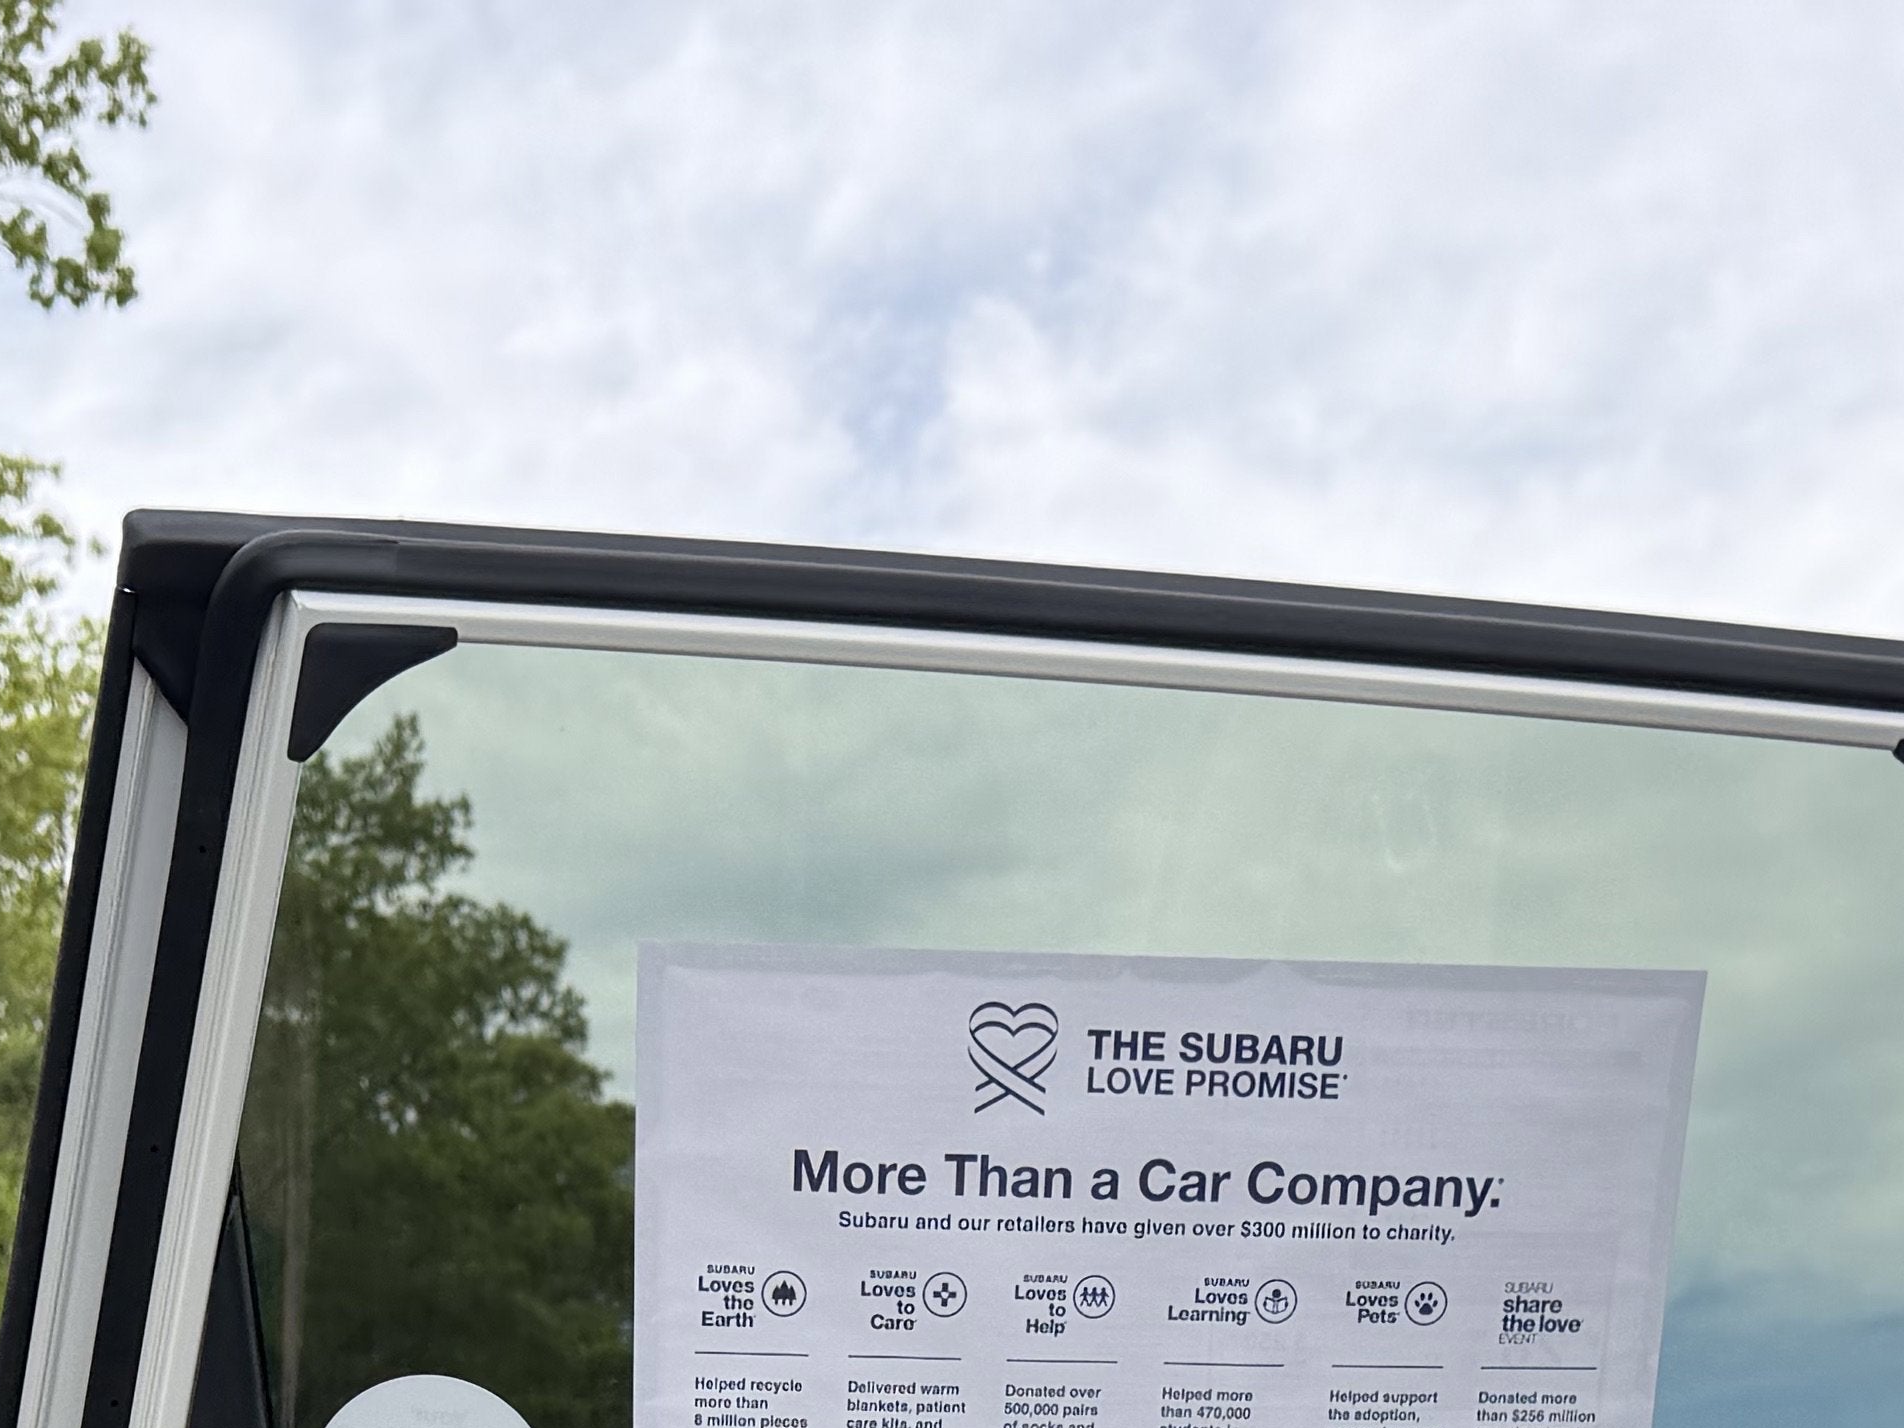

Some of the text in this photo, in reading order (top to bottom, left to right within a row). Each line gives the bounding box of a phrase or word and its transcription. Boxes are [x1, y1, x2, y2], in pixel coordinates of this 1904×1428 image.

[1087, 1029, 1165, 1061] THE
[1179, 1032, 1342, 1066] SUBARU
[1087, 1067, 1342, 1099] LOVE PROMISE
[793, 1149, 926, 1195] More
[944, 1153, 1071, 1198] Than
[1091, 1168, 1118, 1199] a
[1139, 1158, 1231, 1202] Car
[838, 1210, 1454, 1245] Subaru and our retailers have given over $300 million to charity.
[707, 1264, 754, 1274] SUBARU
[870, 1269, 916, 1279] SUBARU
[698, 1276, 754, 1293] Loves
[1023, 1274, 1067, 1283] SUBARU
[1204, 1278, 1249, 1287] SUBARU
[1355, 1280, 1400, 1289] SUBARU
[861, 1281, 915, 1297] Loves
[1015, 1284, 1066, 1300] Loves
[1504, 1282, 1553, 1293] SUBARU
[723, 1295, 753, 1310] the
[1194, 1288, 1247, 1304] Loves
[1346, 1291, 1398, 1307] Loves
[896, 1300, 914, 1314] to
[1048, 1303, 1065, 1316] to
[1503, 1296, 1562, 1313] share
[701, 1311, 753, 1327] Earth
[870, 1314, 914, 1330] Care
[1168, 1305, 1248, 1325] Learning
[1357, 1309, 1397, 1323] Pets
[1026, 1319, 1065, 1336] Help
[1502, 1314, 1581, 1332] the love
[1498, 1333, 1537, 1344] EVENT
[695, 1377, 801, 1394] Helped recycle
[848, 1380, 959, 1394] Delivered warm
[1005, 1384, 1101, 1398] Donated over
[1162, 1387, 1252, 1401] Helped more
[1329, 1390, 1437, 1406] Helped support
[1478, 1391, 1576, 1404] Donated more
[694, 1396, 767, 1409] more than
[847, 1399, 965, 1415] blankets, patient
[1004, 1403, 1097, 1418] 500,000 pairs
[1161, 1405, 1250, 1420] than 470,000
[1328, 1408, 1419, 1423] the adoption,
[1477, 1410, 1595, 1422] than $256 million
[694, 1413, 702, 1425] 8
[707, 1414, 755, 1426] million
[846, 1419, 876, 1428] care
